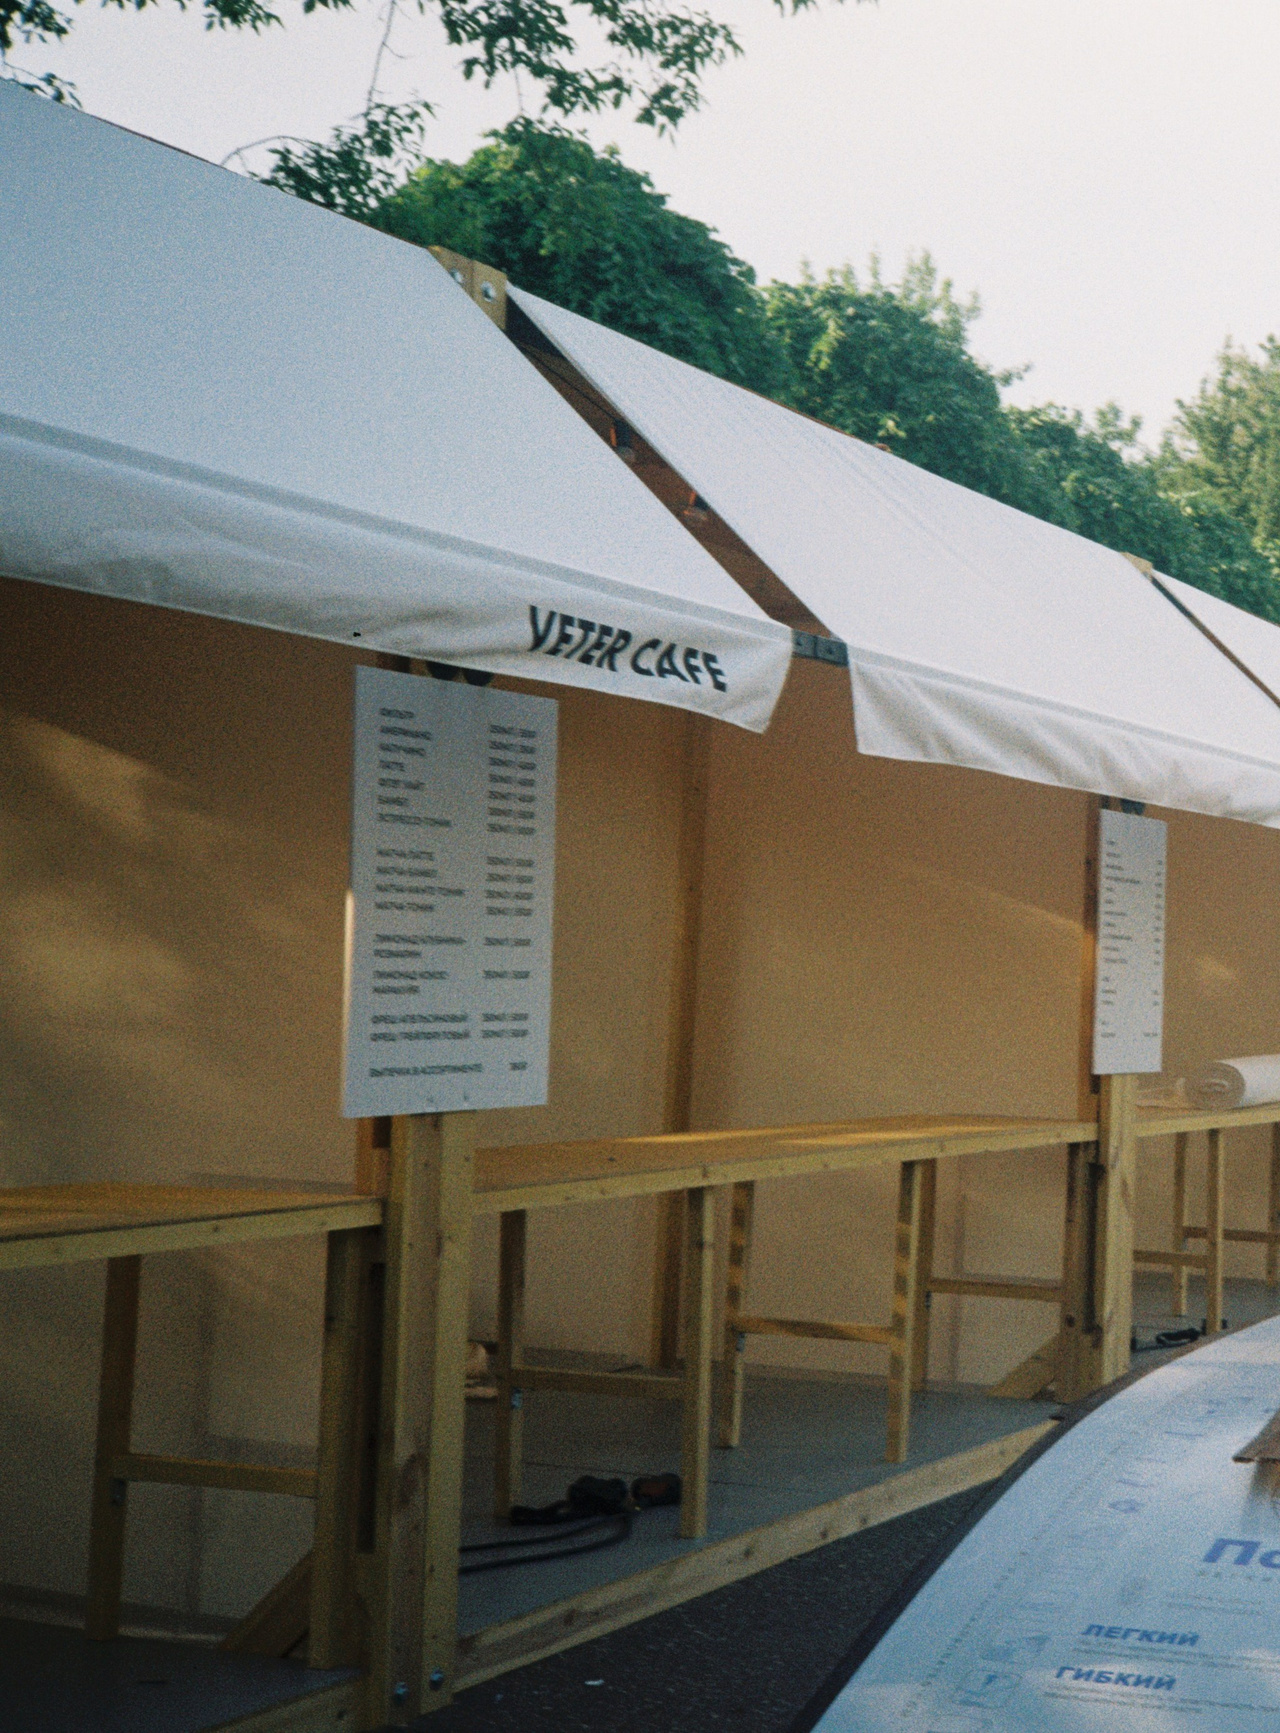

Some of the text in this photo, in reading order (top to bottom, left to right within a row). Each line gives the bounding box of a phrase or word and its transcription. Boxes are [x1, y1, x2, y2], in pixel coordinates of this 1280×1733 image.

[527, 604, 728, 693] VETER CAFE
[1081, 1623, 1200, 1646] ЛЕГКИЙ
[1055, 1665, 1177, 1691] ГИБКИЙ
